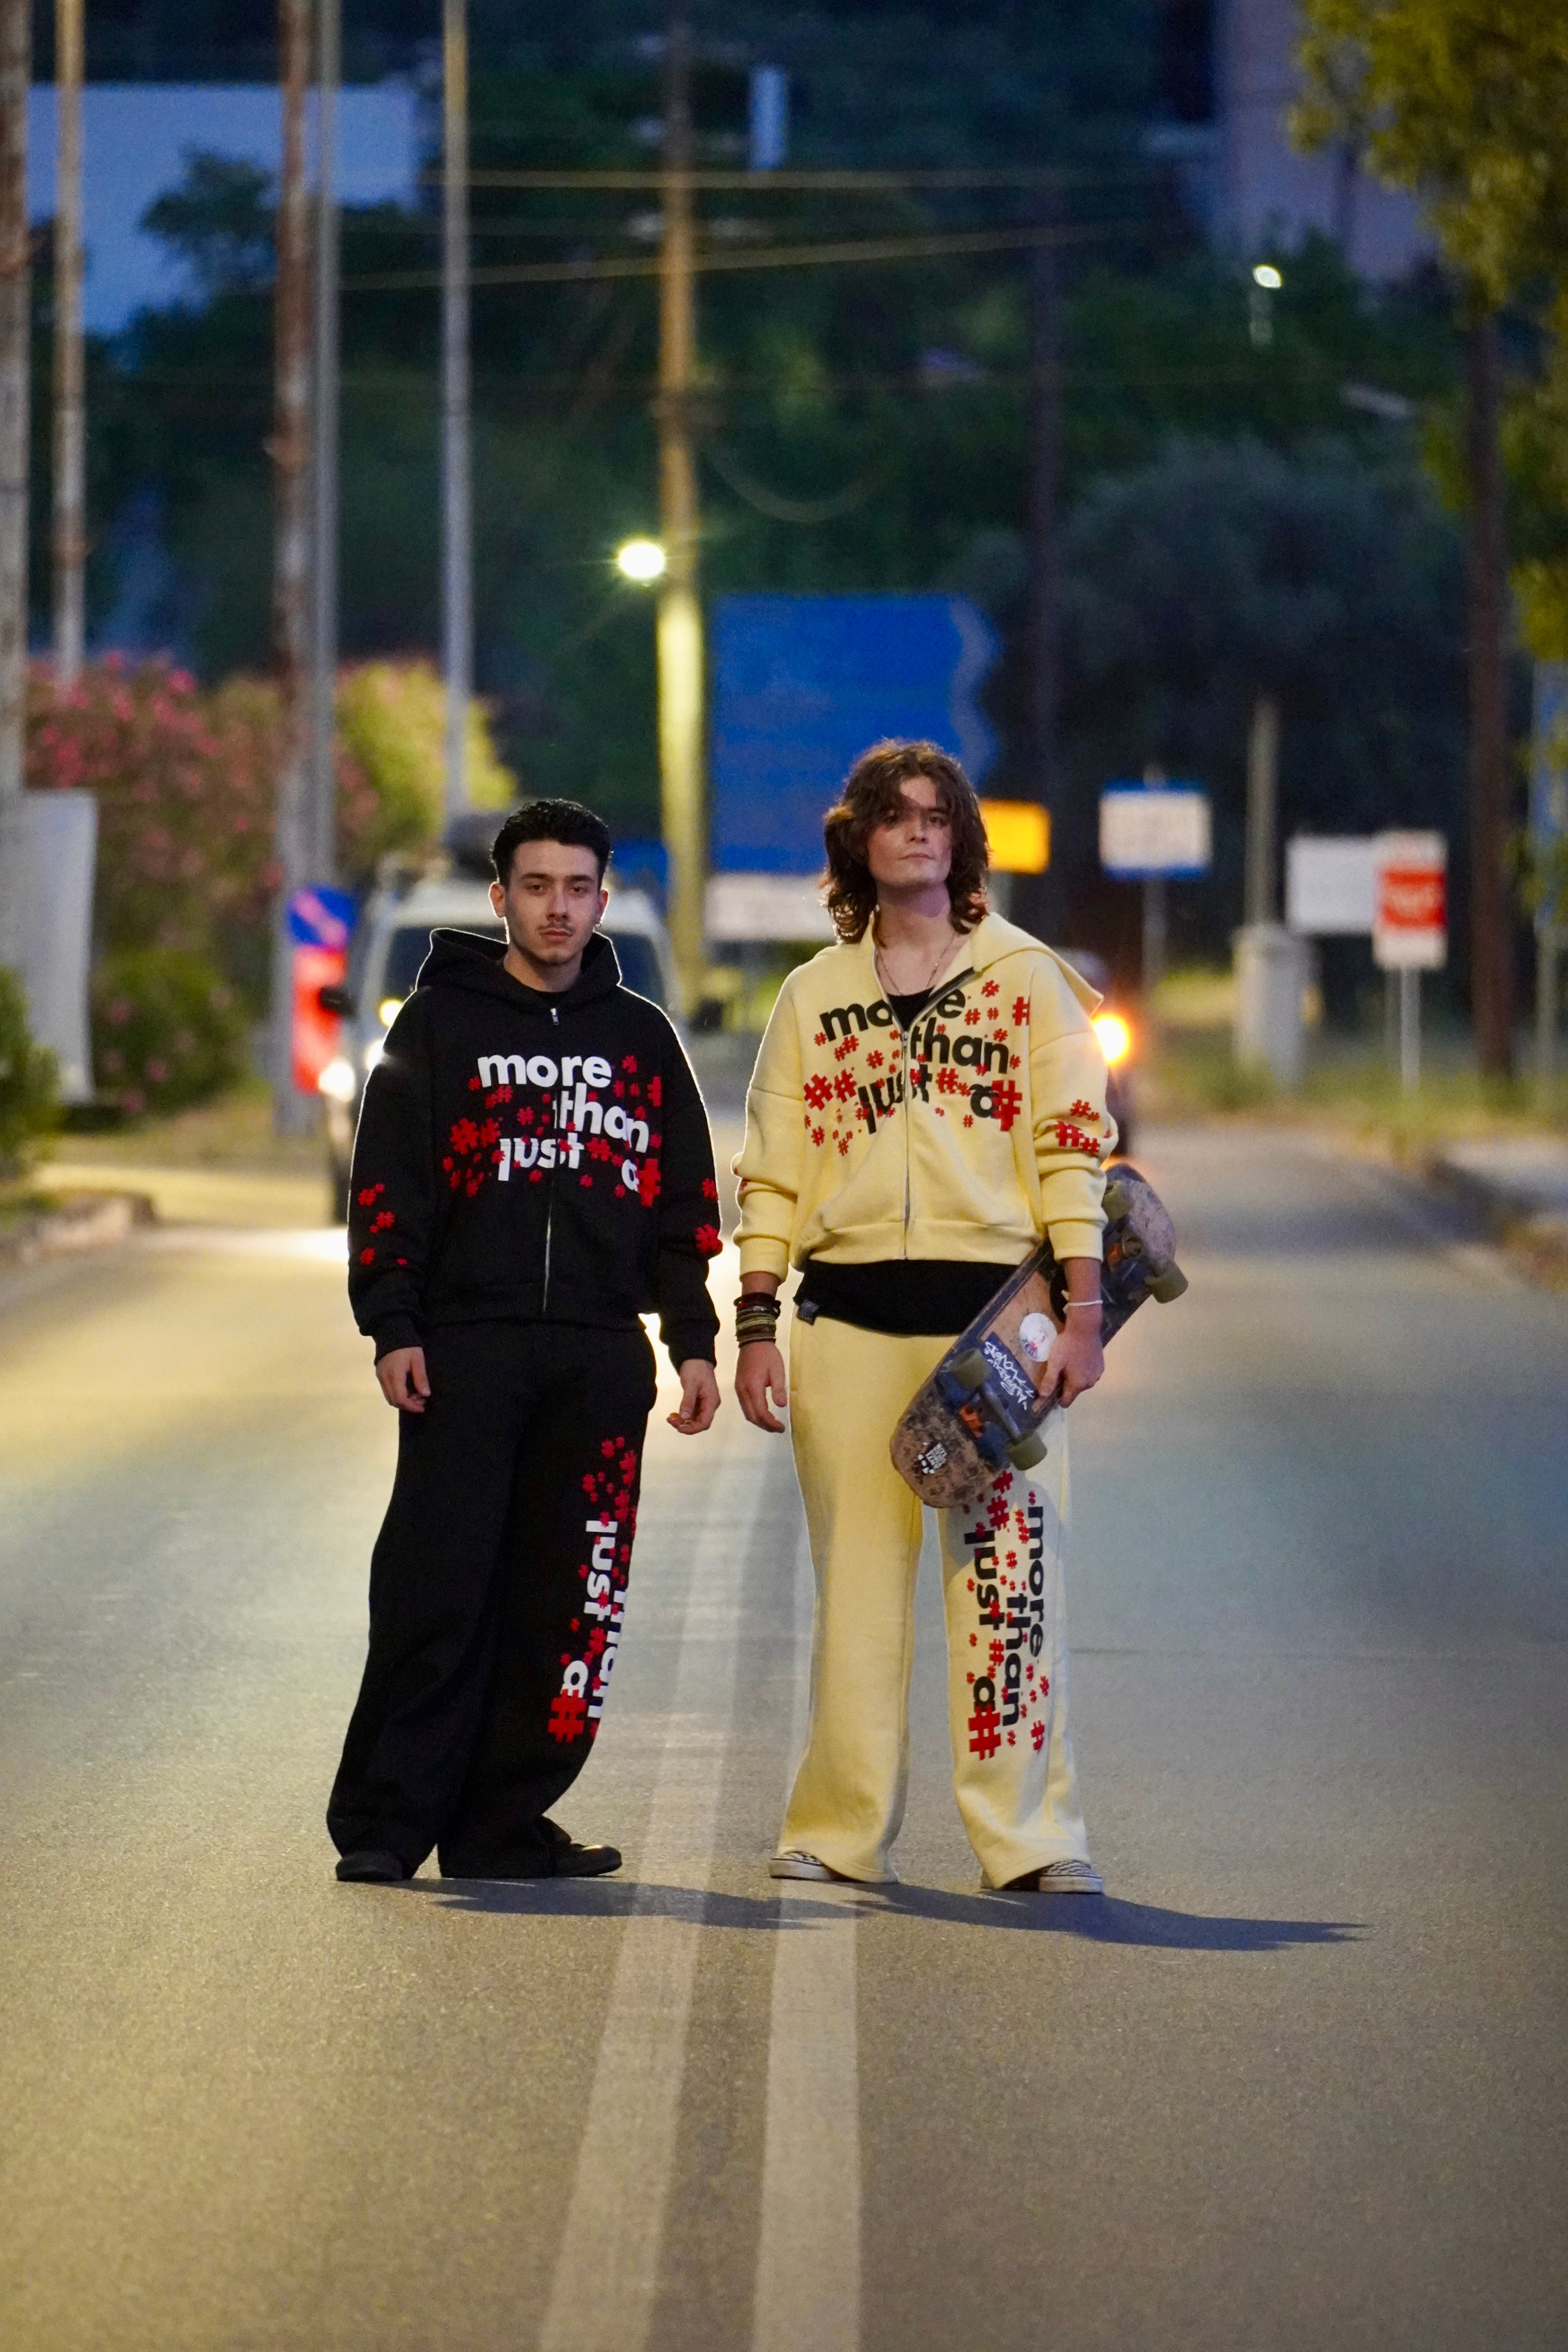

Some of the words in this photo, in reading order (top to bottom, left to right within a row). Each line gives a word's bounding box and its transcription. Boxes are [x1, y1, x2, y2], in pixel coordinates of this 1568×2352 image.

[820, 989, 966, 1041] moe
[910, 1017, 1009, 1074] than
[477, 1054, 612, 1088] more
[552, 1082, 649, 1153] than
[498, 1132, 584, 1181] just
[584, 1520, 618, 1621] just
[964, 1530, 1005, 1630] just
[1027, 1506, 1044, 1657] more
[1002, 1593, 1031, 1726] than
